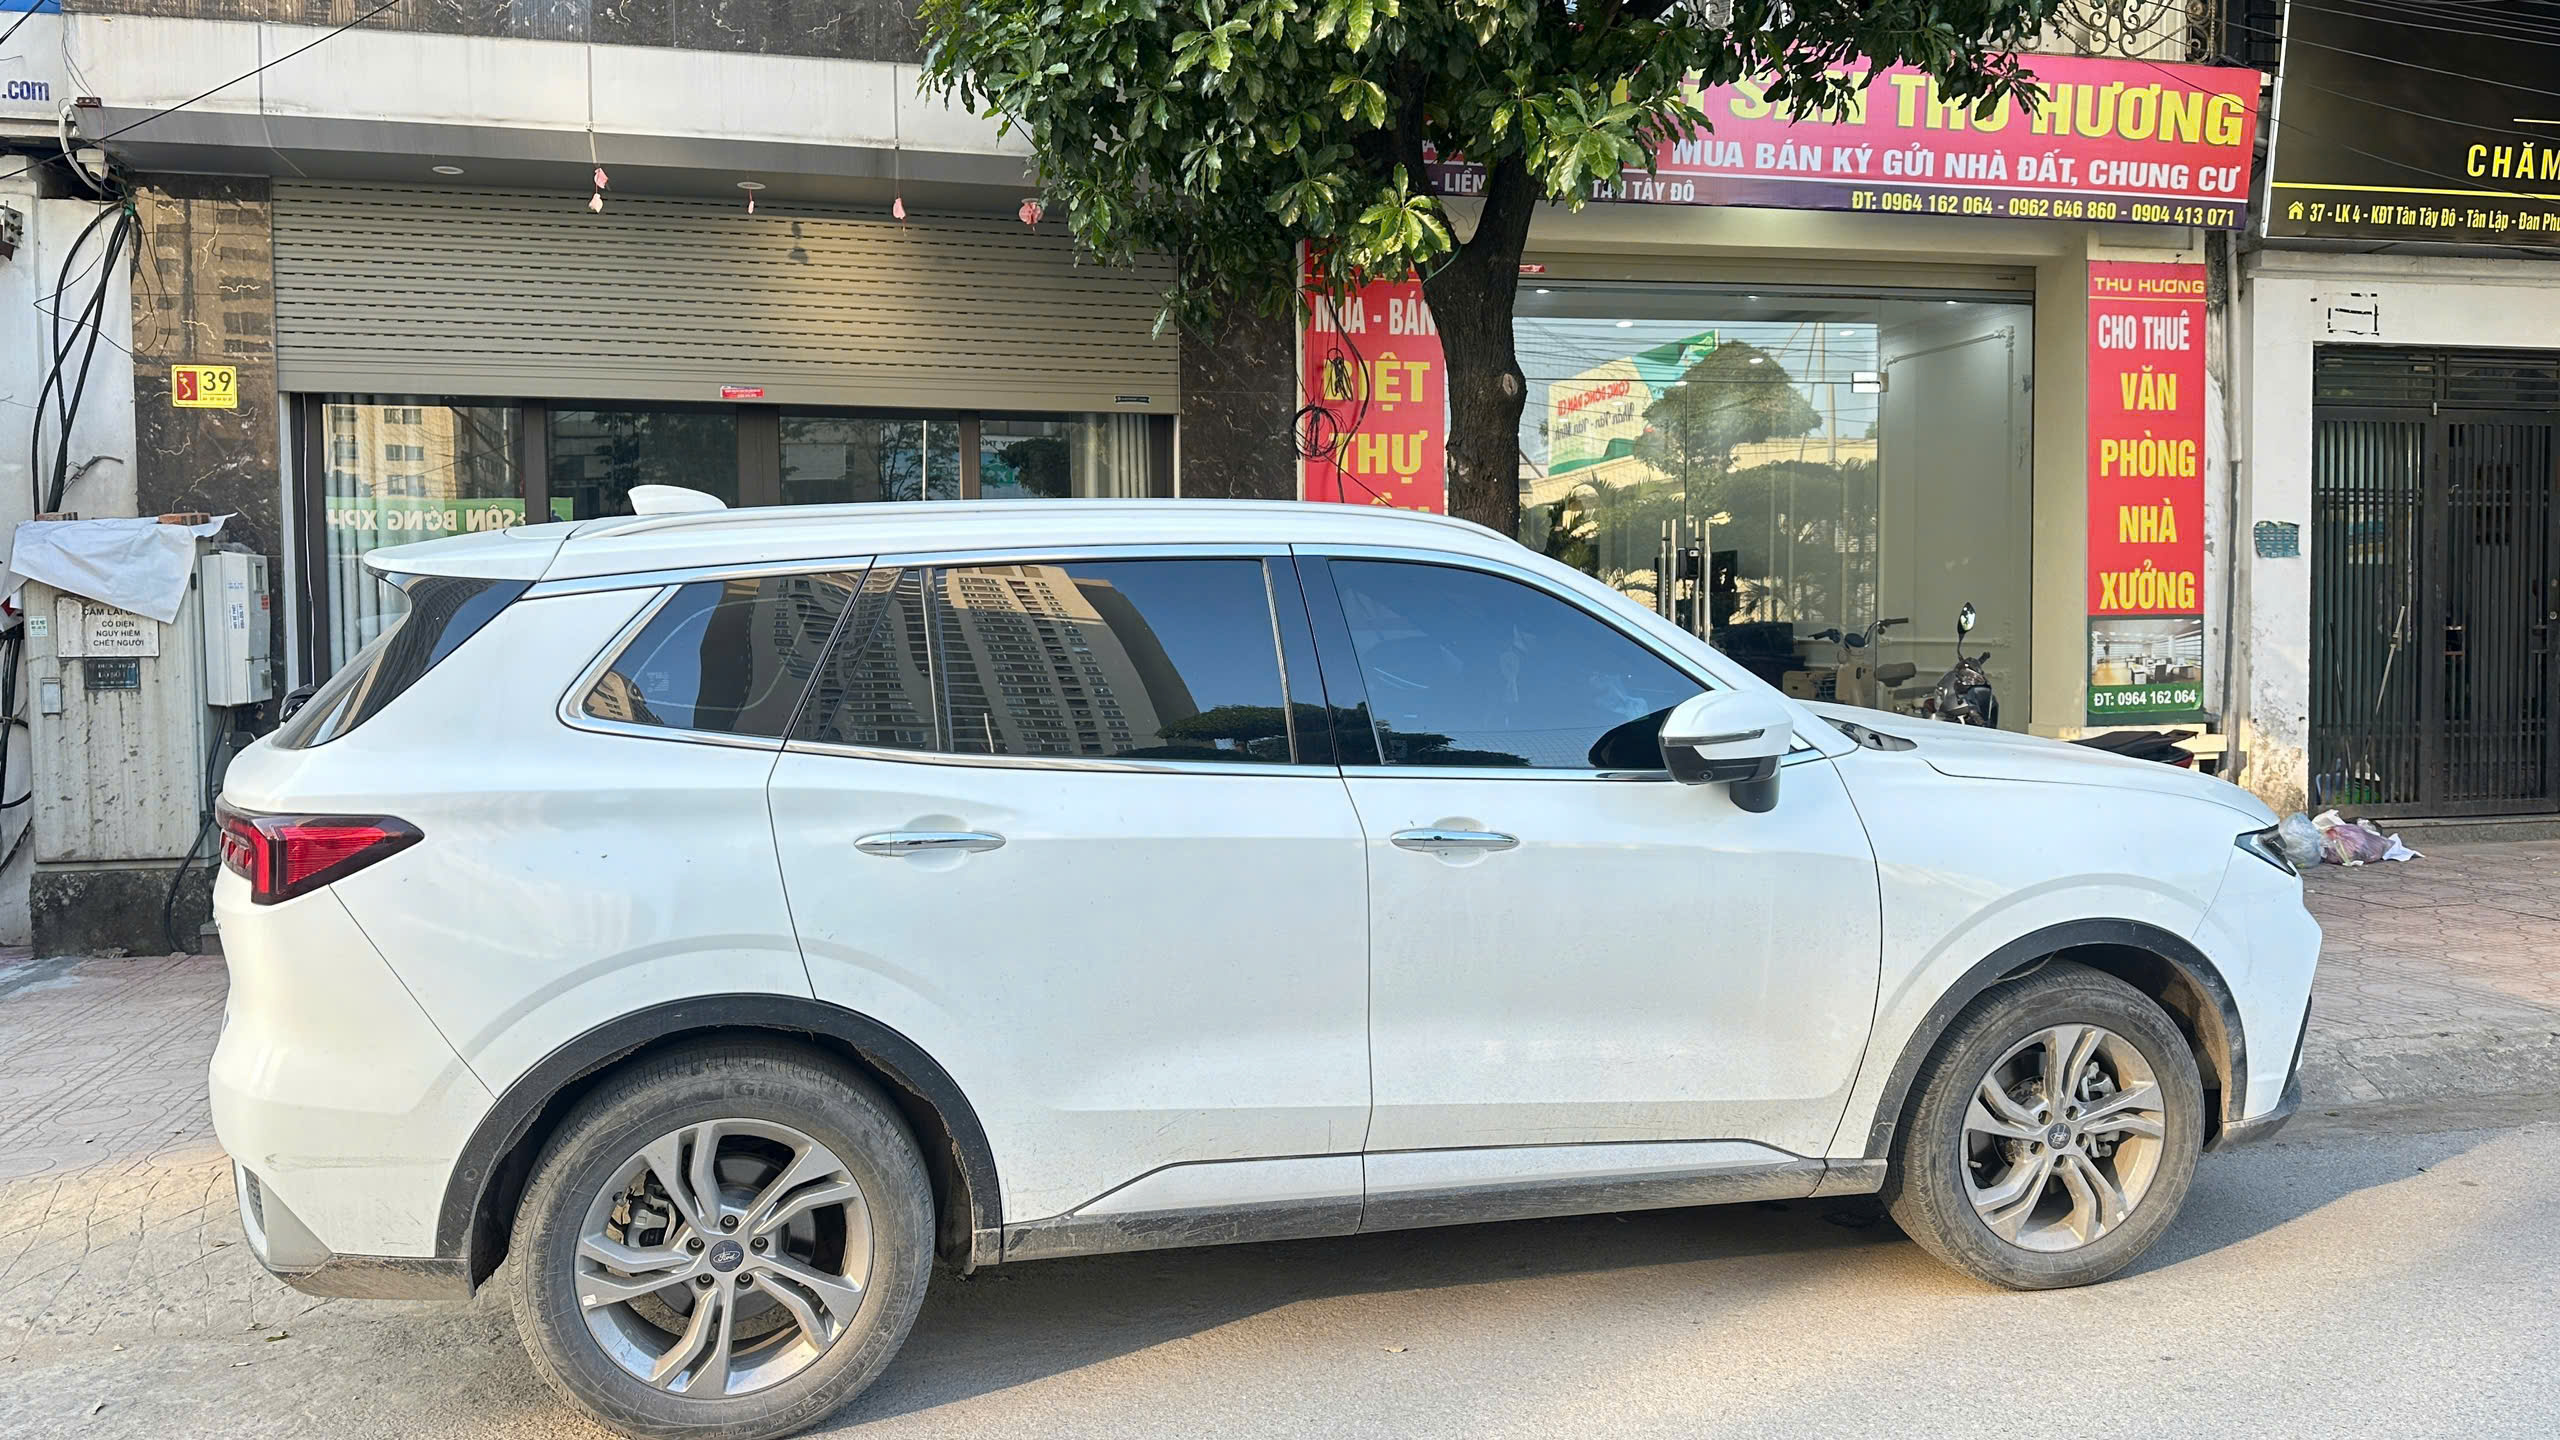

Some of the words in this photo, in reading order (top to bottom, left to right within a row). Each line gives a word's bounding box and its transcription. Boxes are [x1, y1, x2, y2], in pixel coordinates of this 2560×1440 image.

[2032, 81, 2245, 146] HƯƠNG
[1672, 138, 1744, 168] MUA
[1755, 138, 1822, 171] BÁN
[1833, 143, 1873, 174] KÝ
[1883, 142, 1934, 177] GỬI
[1944, 149, 2008, 180] NHÀ
[2017, 148, 2078, 186] ĐẤT,
[2089, 159, 2189, 190] CHUNG
[2198, 165, 2241, 192] CƯ
[1633, 177, 1665, 200] TÂY
[1671, 179, 1694, 202] ĐÔ
[1852, 191, 1876, 210] ĐT:
[1882, 192, 1923, 212] 0964
[1929, 194, 1957, 213] 162
[1963, 196, 1993, 214] 064
[2009, 198, 2048, 217] 0962
[2053, 200, 2082, 218] 646
[2087, 202, 2117, 220] 860
[2132, 204, 2170, 222] 0904
[2174, 206, 2202, 224] 413
[2207, 209, 2234, 226] 071
[2309, 203, 2325, 222] 37
[2335, 204, 2350, 223] LK
[2352, 205, 2360, 223] 4
[2371, 205, 2394, 224] KĐT
[2396, 206, 2416, 225] Tân
[2419, 207, 2439, 228] Tây
[2440, 208, 2456, 227] Đô
[2467, 209, 2486, 228] Tân
[2488, 210, 2509, 233] Lập
[2518, 212, 2540, 230] Đan
[2094, 277, 2132, 292] THU
[2138, 279, 2204, 293] HƯƠNG
[1315, 295, 1366, 334] MUA
[1389, 290, 1436, 336] BÁN
[2098, 314, 2137, 349] CHO
[2142, 309, 2190, 350] THUÊ
[203, 371, 231, 391] 39
[1323, 352, 1430, 411] BIỆT
[2120, 365, 2177, 411] VĂN
[1329, 430, 1428, 484] THỰ
[2100, 430, 2196, 477] PHÒNG
[2118, 498, 2178, 543] NHÀ
[2099, 559, 2196, 610] XƯỞNG
[2094, 692, 2114, 707] ĐT:
[2118, 691, 2147, 706] 0964
[2150, 690, 2171, 704] 162
[2174, 689, 2196, 703] 064
